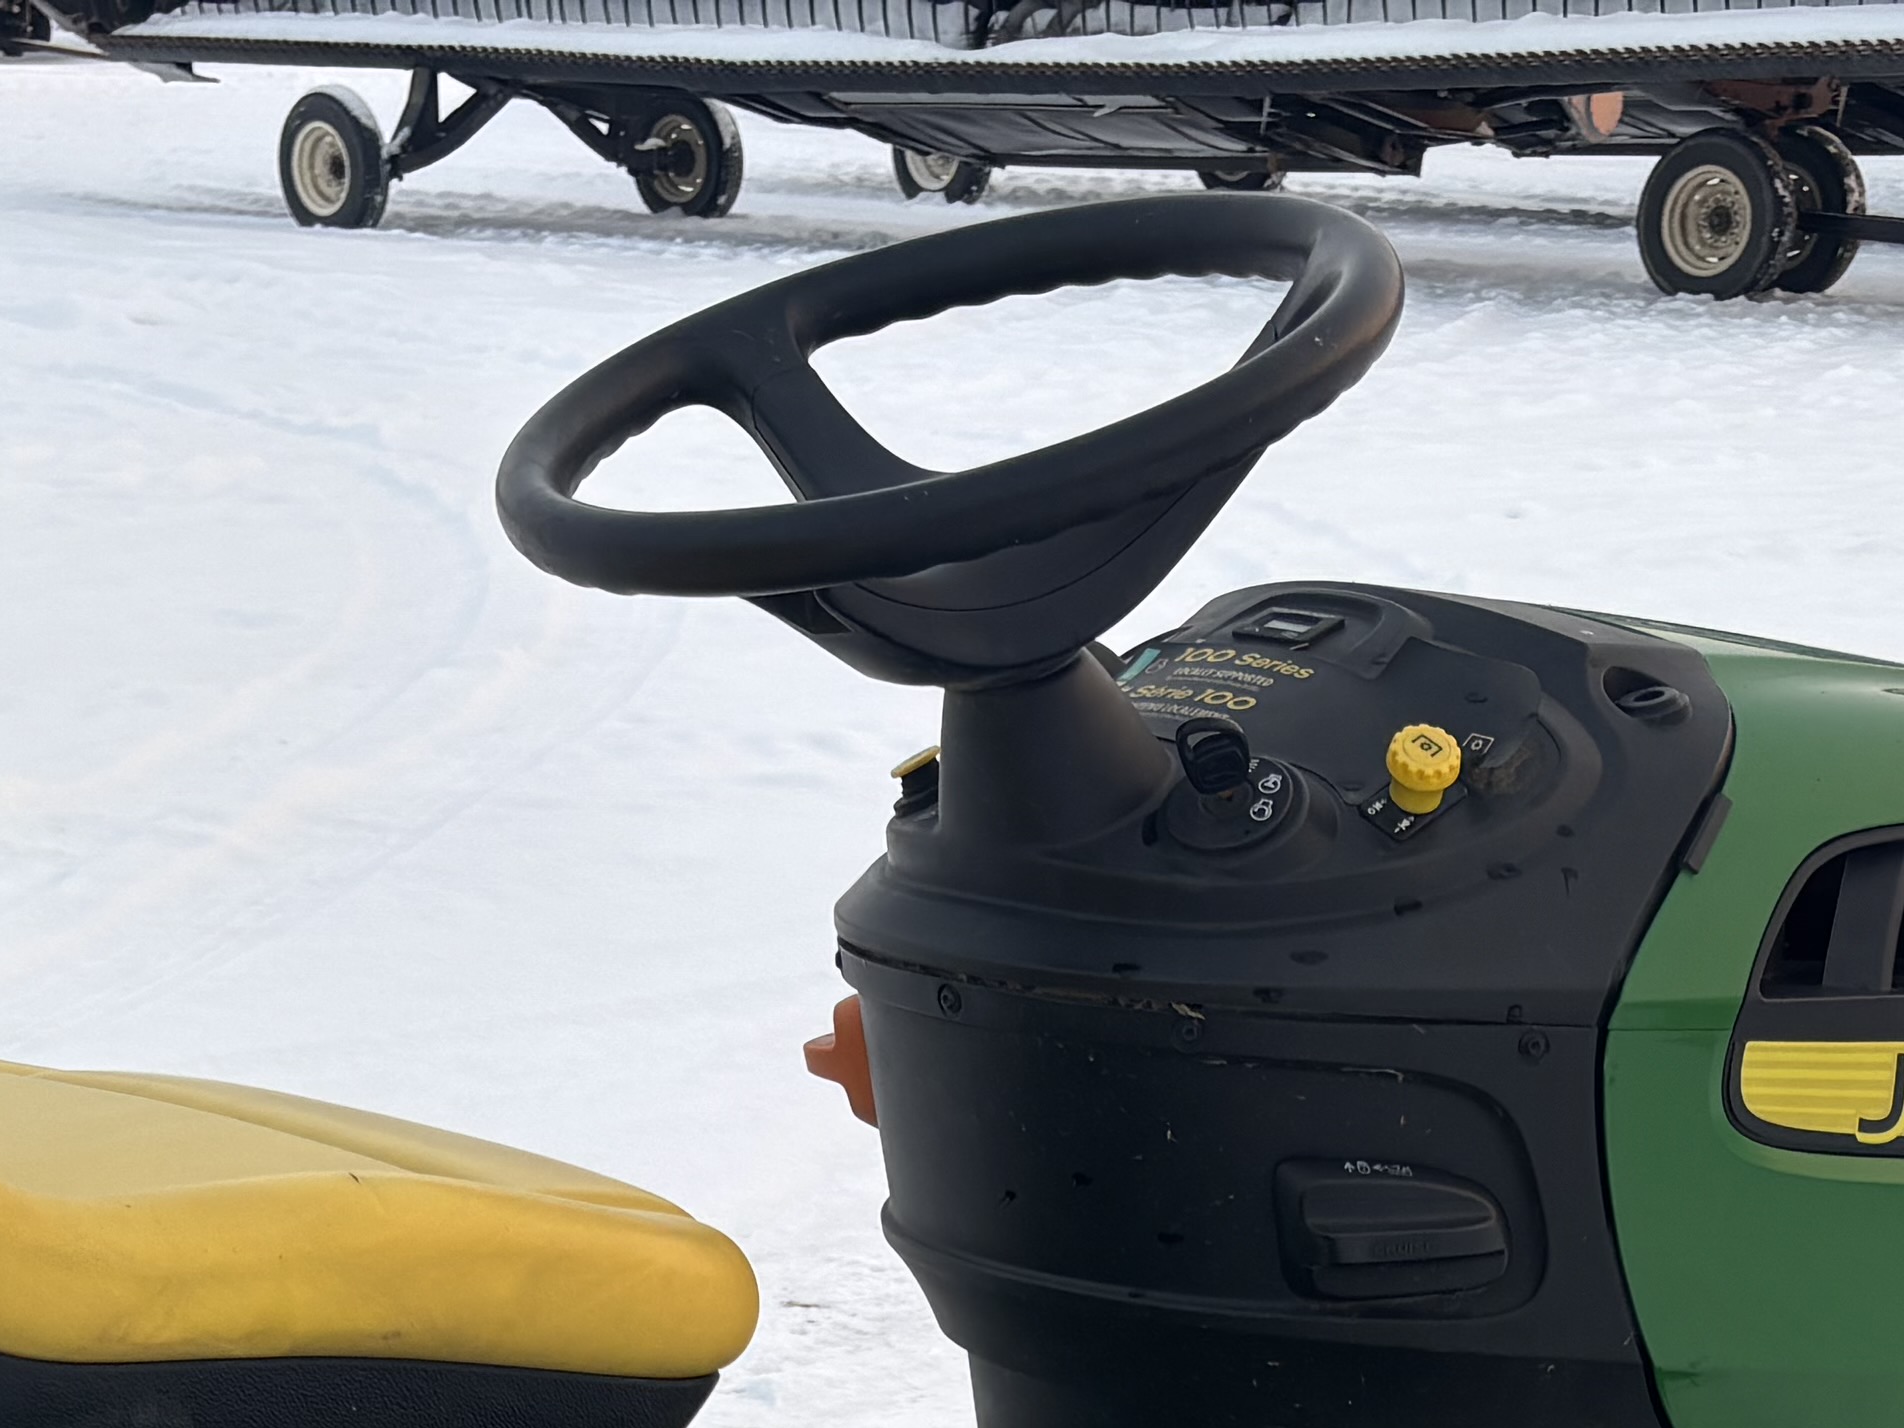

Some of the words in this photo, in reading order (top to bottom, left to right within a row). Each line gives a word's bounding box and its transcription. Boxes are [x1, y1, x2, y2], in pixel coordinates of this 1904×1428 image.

[1174, 648, 1236, 662] 100
[1234, 653, 1314, 679] Series
[1194, 688, 1256, 710] 100
